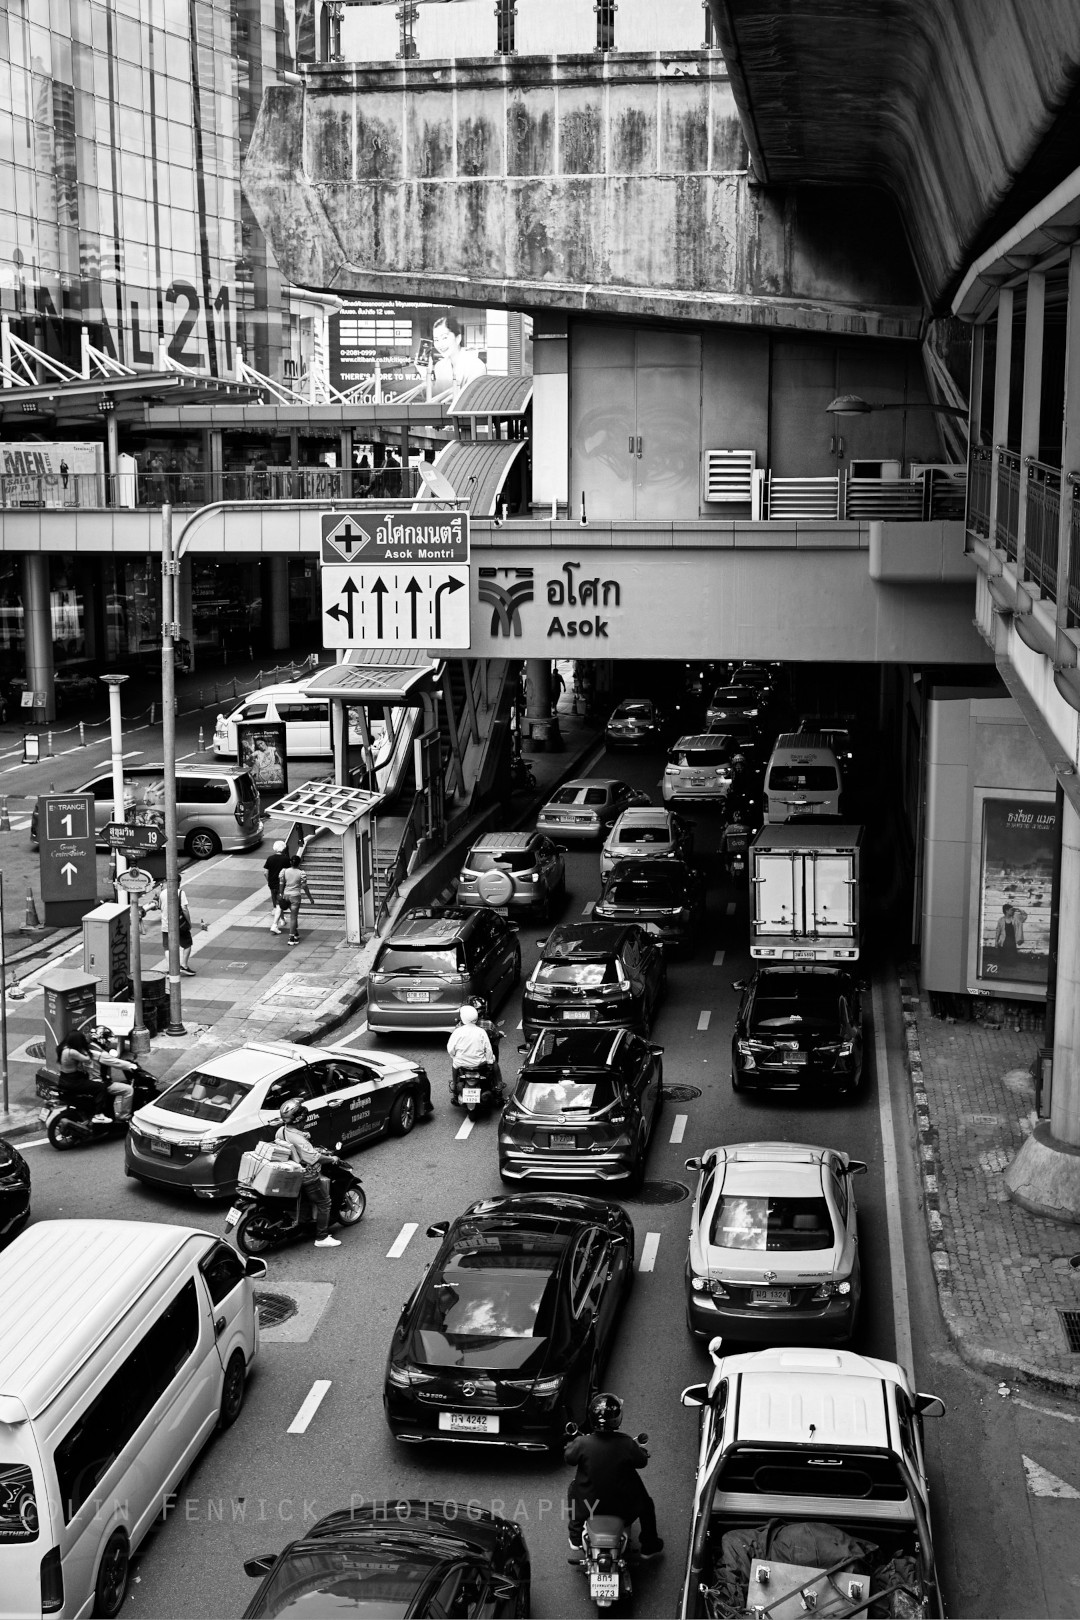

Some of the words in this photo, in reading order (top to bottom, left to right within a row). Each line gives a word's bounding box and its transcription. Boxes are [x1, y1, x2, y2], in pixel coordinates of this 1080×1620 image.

[394, 373, 404, 381] TO
[376, 515, 462, 545] อโศกมนตรี
[384, 549, 413, 559] Asok
[418, 548, 454, 559] Montri
[478, 567, 534, 578] BTS
[546, 561, 621, 607] อโศก
[546, 615, 609, 638] Asok
[61, 814, 72, 836] 1
[109, 827, 134, 837] สุขุมวิท
[147, 832, 158, 844] 19
[466, 1415, 488, 1425] 4242
[595, 1590, 615, 1598] 1273
